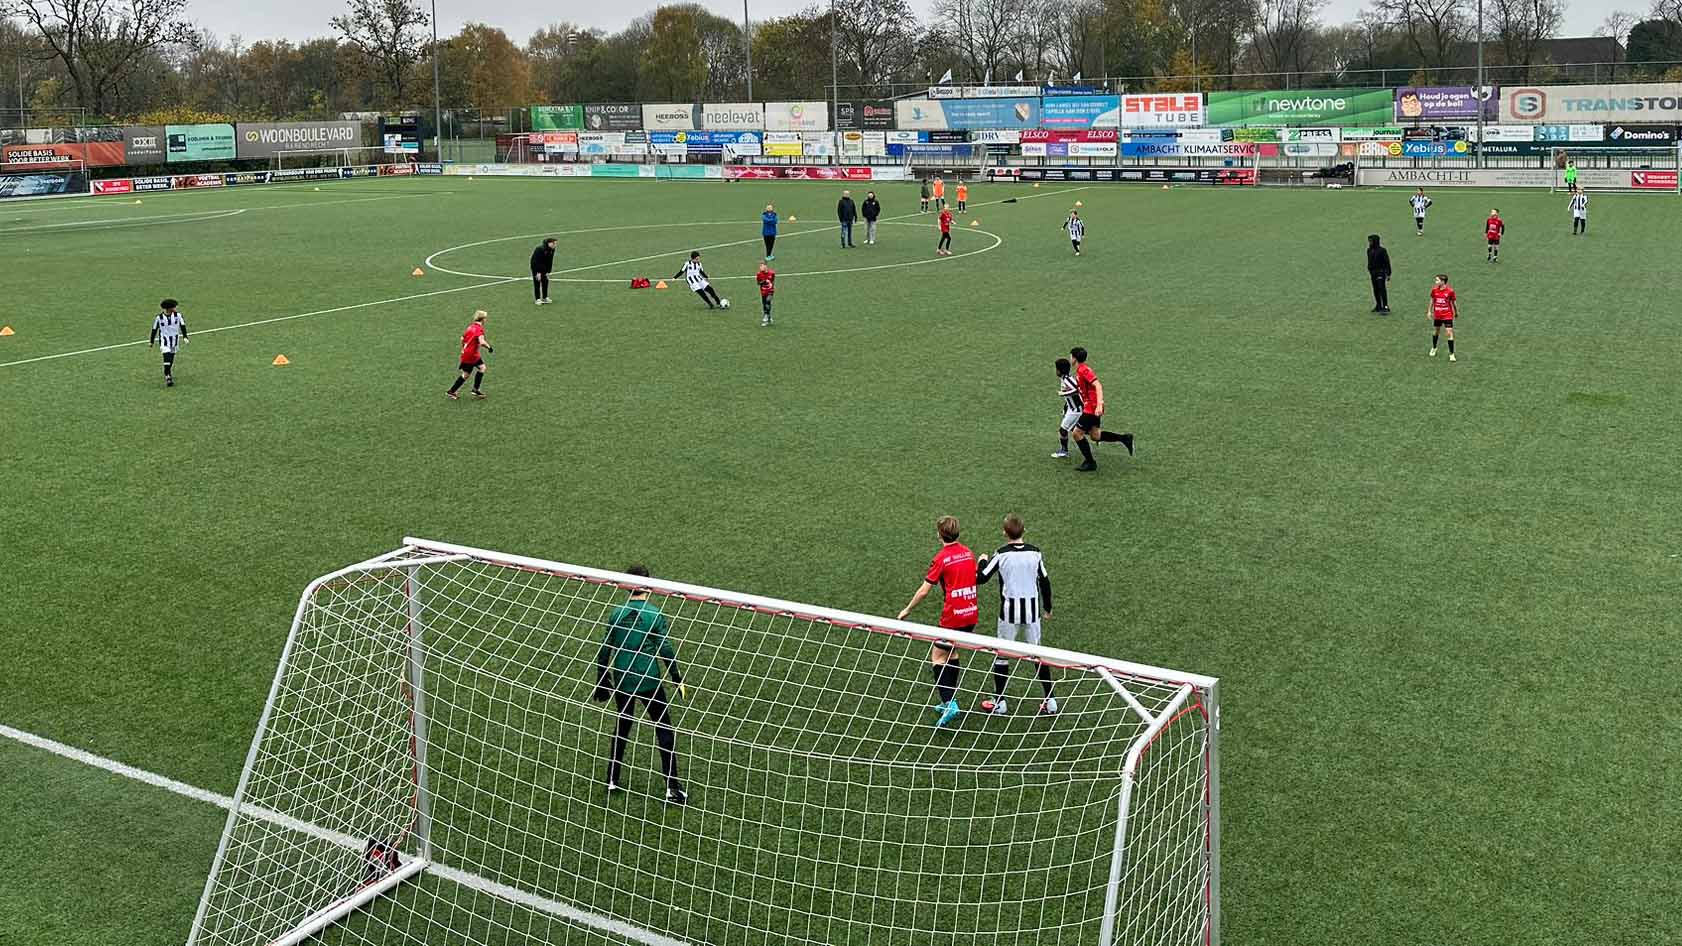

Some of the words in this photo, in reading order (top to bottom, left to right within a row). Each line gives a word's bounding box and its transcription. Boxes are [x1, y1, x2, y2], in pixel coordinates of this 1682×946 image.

[1268, 96, 1346, 110] newtone
[1562, 97, 1682, 111] TRANSTO
[706, 110, 760, 123] neelevat
[1155, 113, 1198, 122] TUBE
[260, 128, 353, 142] WOONBOULEVARD
[1624, 131, 1669, 139] Domino's
[8, 150, 32, 158] SOLIDE
[1136, 145, 1180, 154] AMBACHT
[1184, 145, 1258, 154] KLIMAATSERVIC
[1389, 170, 1471, 180] AMBACHT-IT
